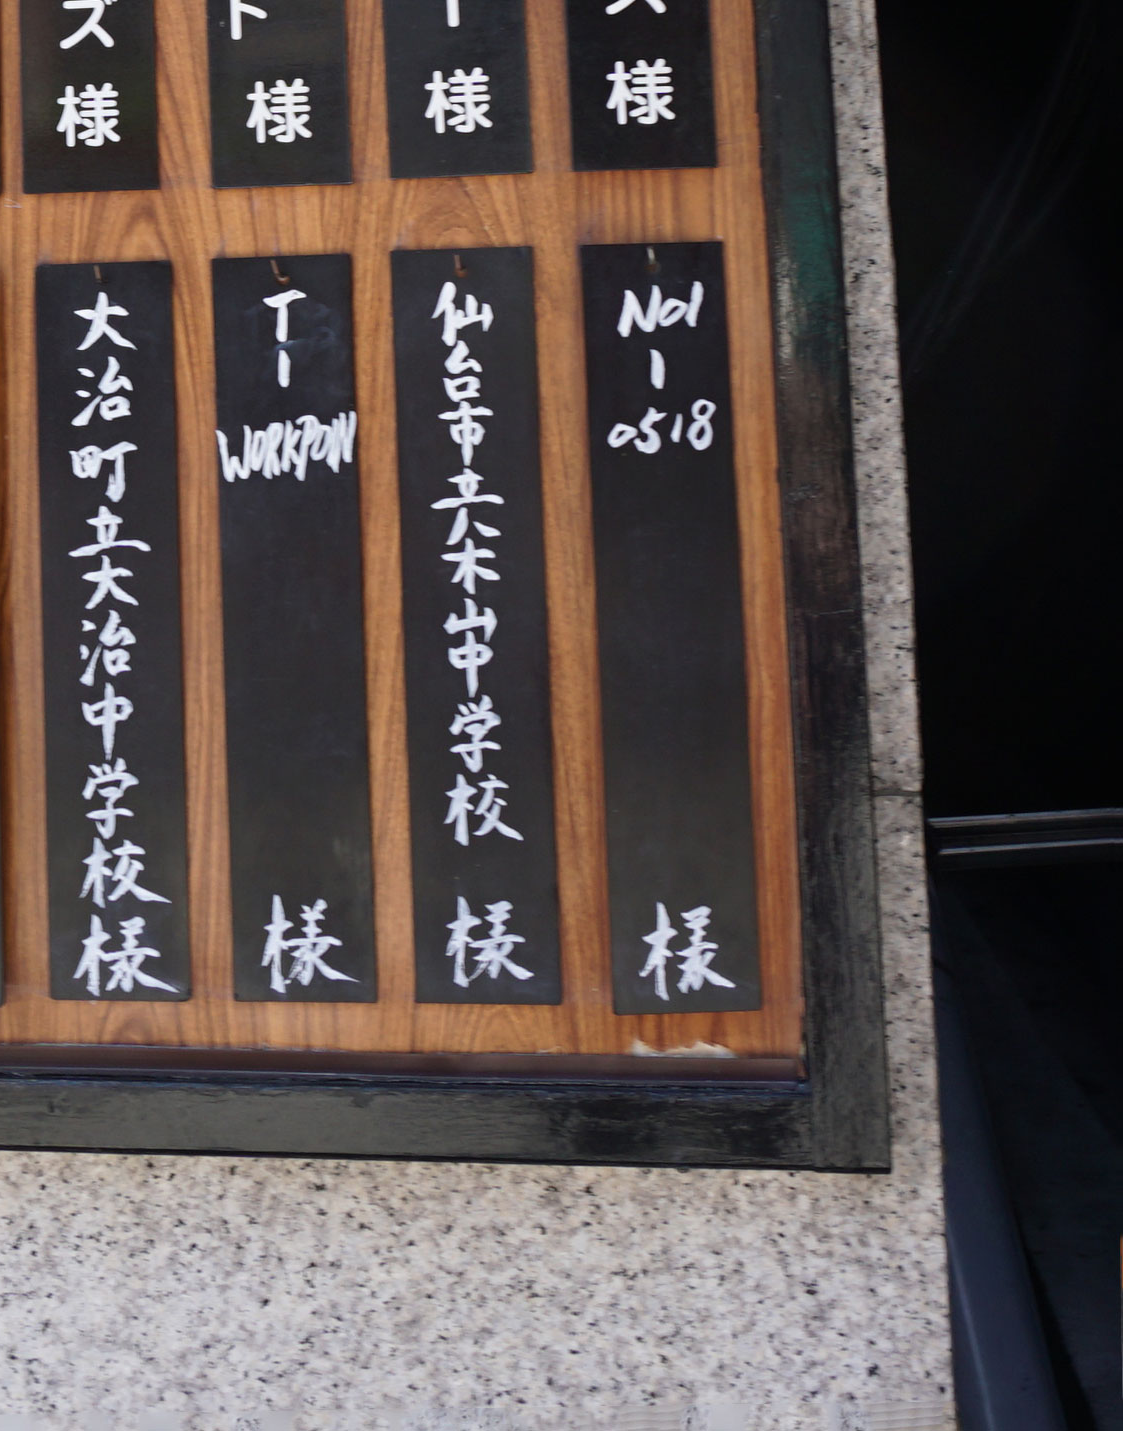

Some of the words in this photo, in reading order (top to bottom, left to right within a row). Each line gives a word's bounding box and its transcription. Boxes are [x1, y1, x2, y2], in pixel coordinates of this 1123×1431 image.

[247, 79, 312, 143] 様
[69, 292, 180, 996] 大治町立大治中学校様
[262, 895, 360, 994] 様
[639, 903, 735, 1001] 様
